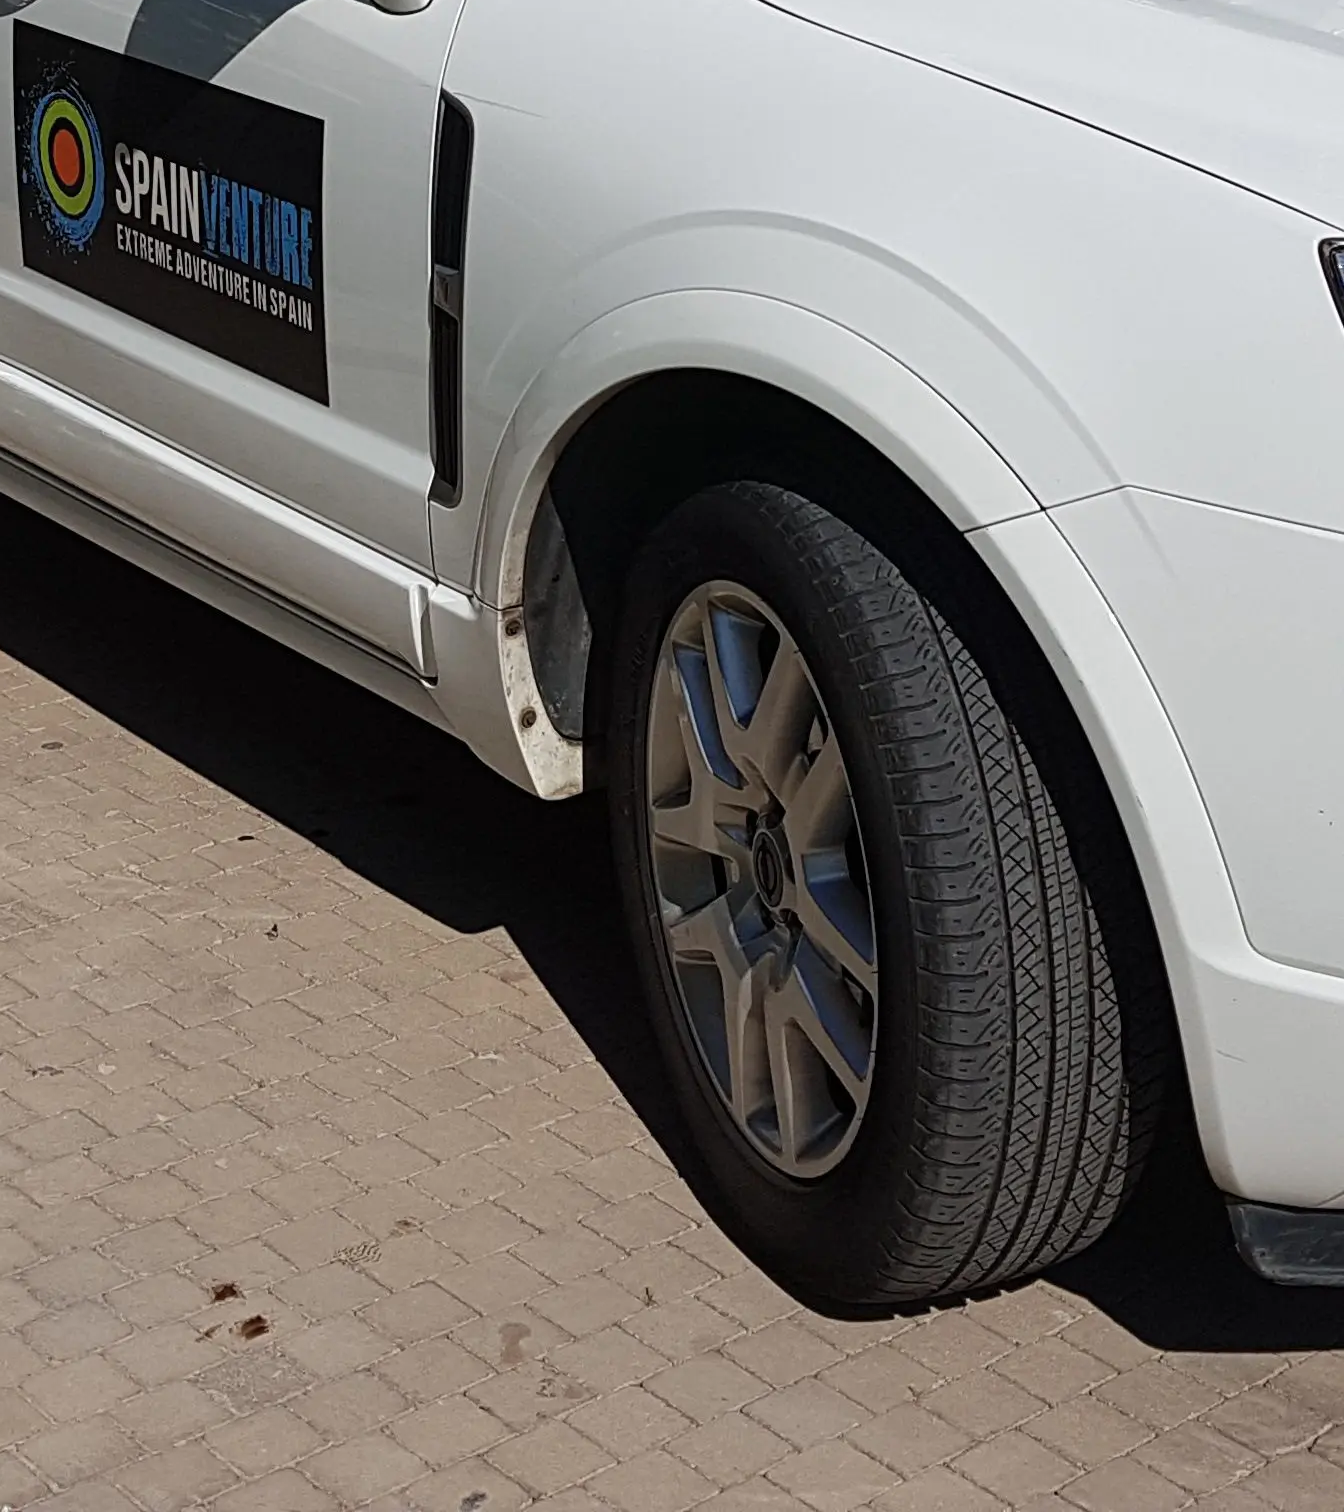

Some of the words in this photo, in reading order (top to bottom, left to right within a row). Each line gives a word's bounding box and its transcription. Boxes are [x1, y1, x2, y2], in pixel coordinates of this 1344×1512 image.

[114, 143, 314, 290] SPAINVENTURE
[116, 223, 174, 271] EXTREME
[175, 248, 251, 306] ADVENTURE
[252, 280, 268, 313] IN
[269, 287, 313, 332] SPAIN
